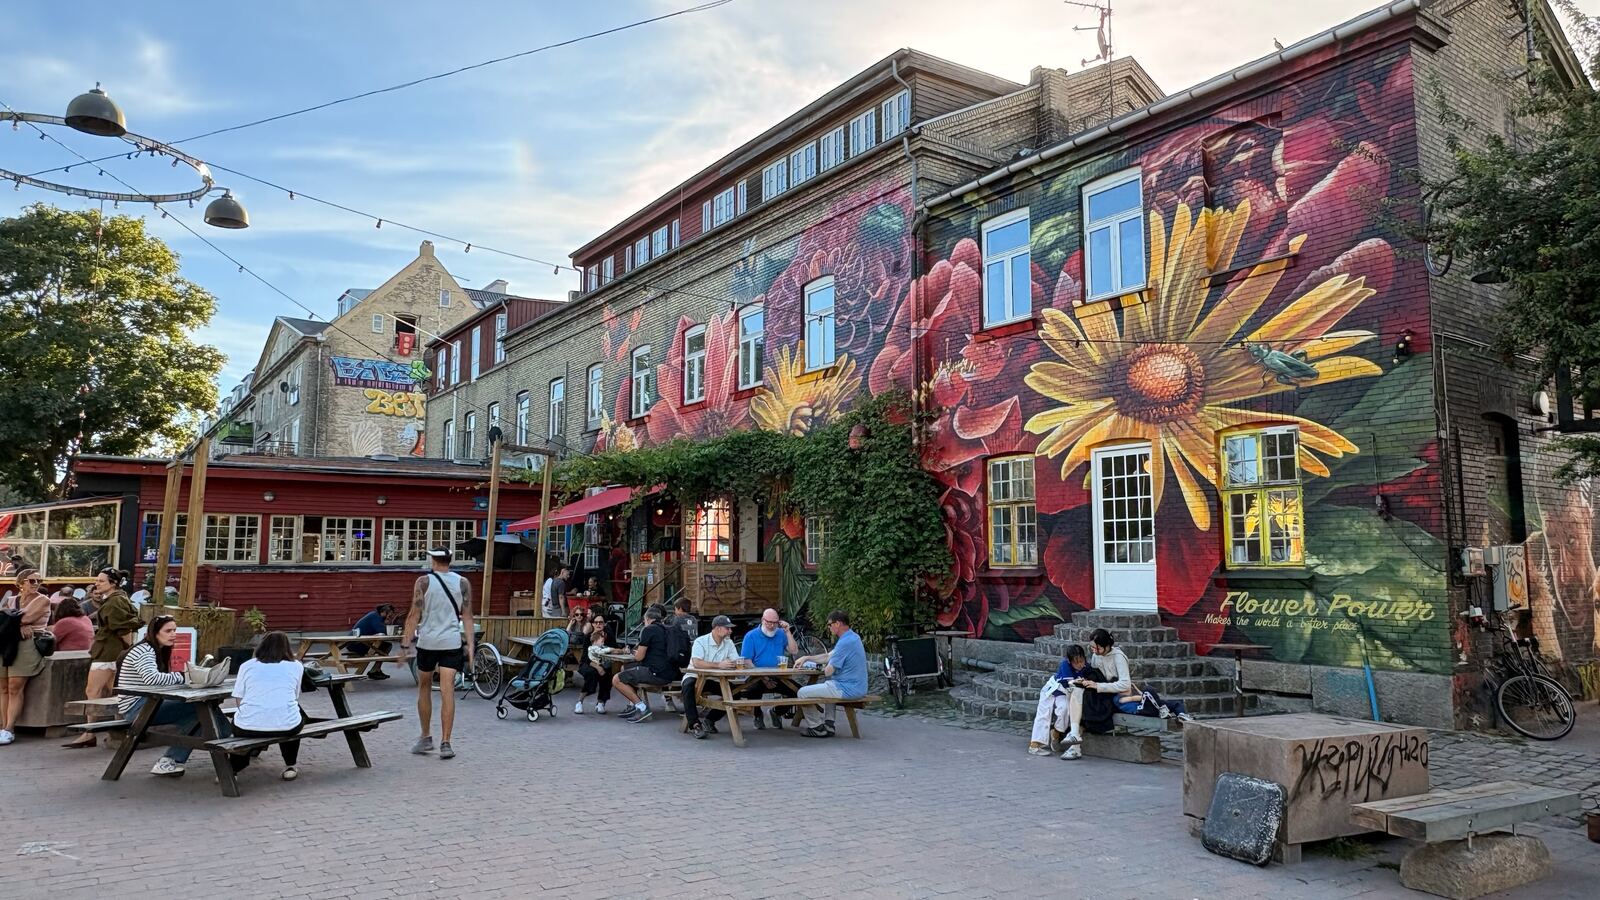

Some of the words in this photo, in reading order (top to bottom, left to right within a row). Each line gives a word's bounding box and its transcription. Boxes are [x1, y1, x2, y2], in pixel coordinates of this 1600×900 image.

[1220, 591, 1319, 617] Flower
[1327, 593, 1436, 621] Power
[1236, 616, 1250, 626] the
[1255, 616, 1280, 628] world
[1286, 620, 1293, 628] a
